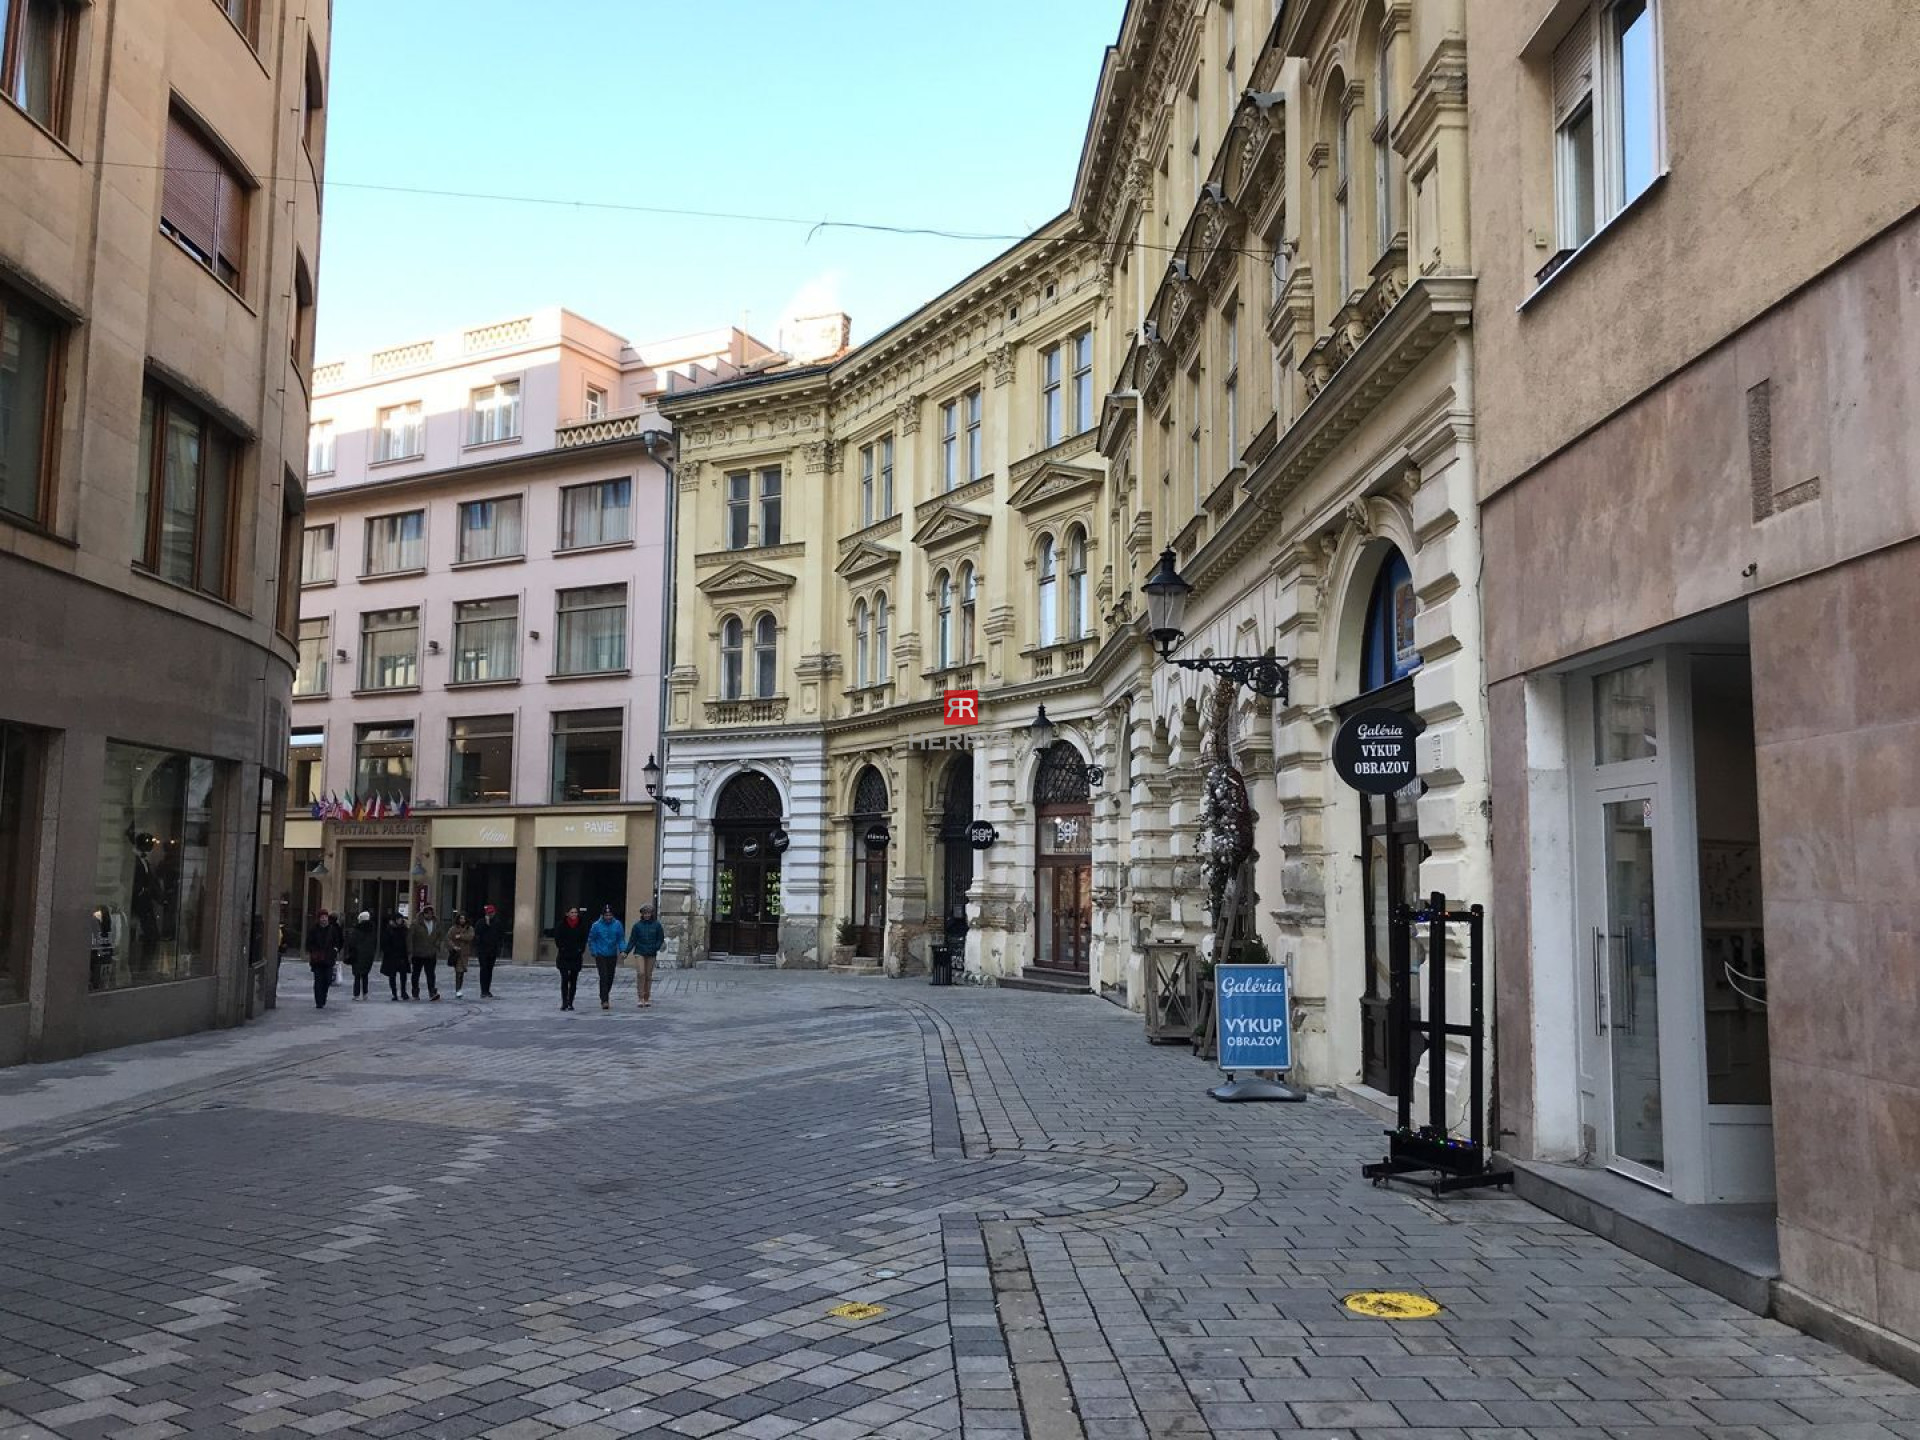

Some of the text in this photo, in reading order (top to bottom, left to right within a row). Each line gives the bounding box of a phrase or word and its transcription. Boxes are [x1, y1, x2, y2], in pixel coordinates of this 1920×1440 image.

[1357, 723, 1403, 739] Galéria
[1361, 742, 1401, 757] VÝKUP
[1354, 761, 1410, 774] OBRAZOV
[971, 828, 993, 837] KOM
[1057, 822, 1078, 833] KOM
[1221, 976, 1283, 998] Galéria
[1225, 1014, 1283, 1033] VÝKUP
[1226, 1036, 1282, 1046] OBRAZOV
